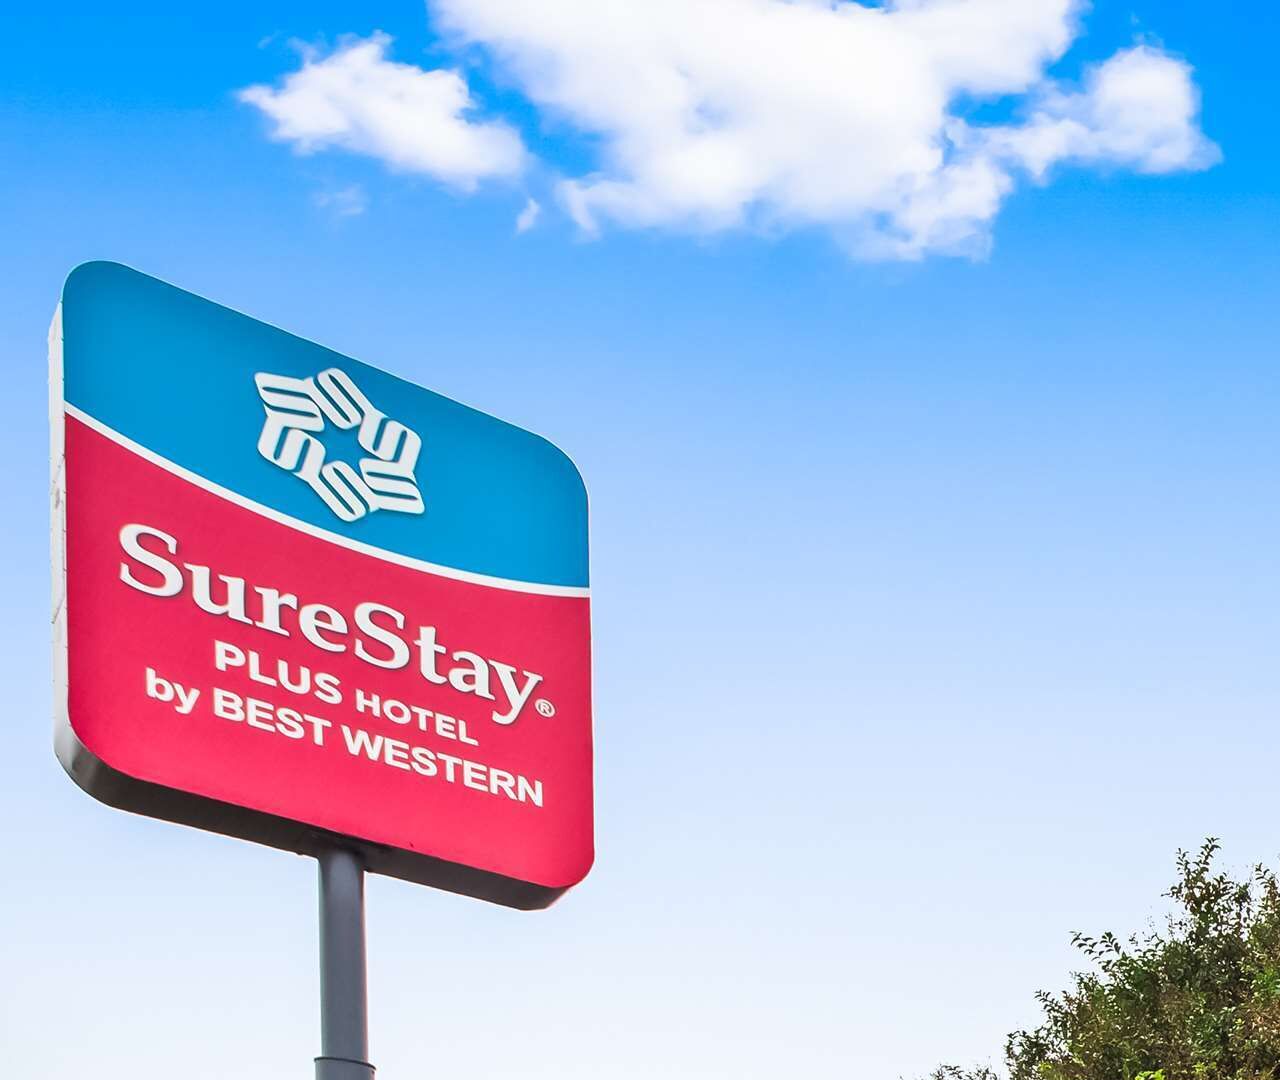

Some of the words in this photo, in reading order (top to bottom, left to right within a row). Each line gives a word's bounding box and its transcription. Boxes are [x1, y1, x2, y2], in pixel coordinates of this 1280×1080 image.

[145, 667, 201, 714] by
[213, 687, 332, 746] BEST
[341, 724, 543, 807] WESTERN
[214, 640, 343, 705] PLUS
[355, 689, 479, 746] HOTEL
